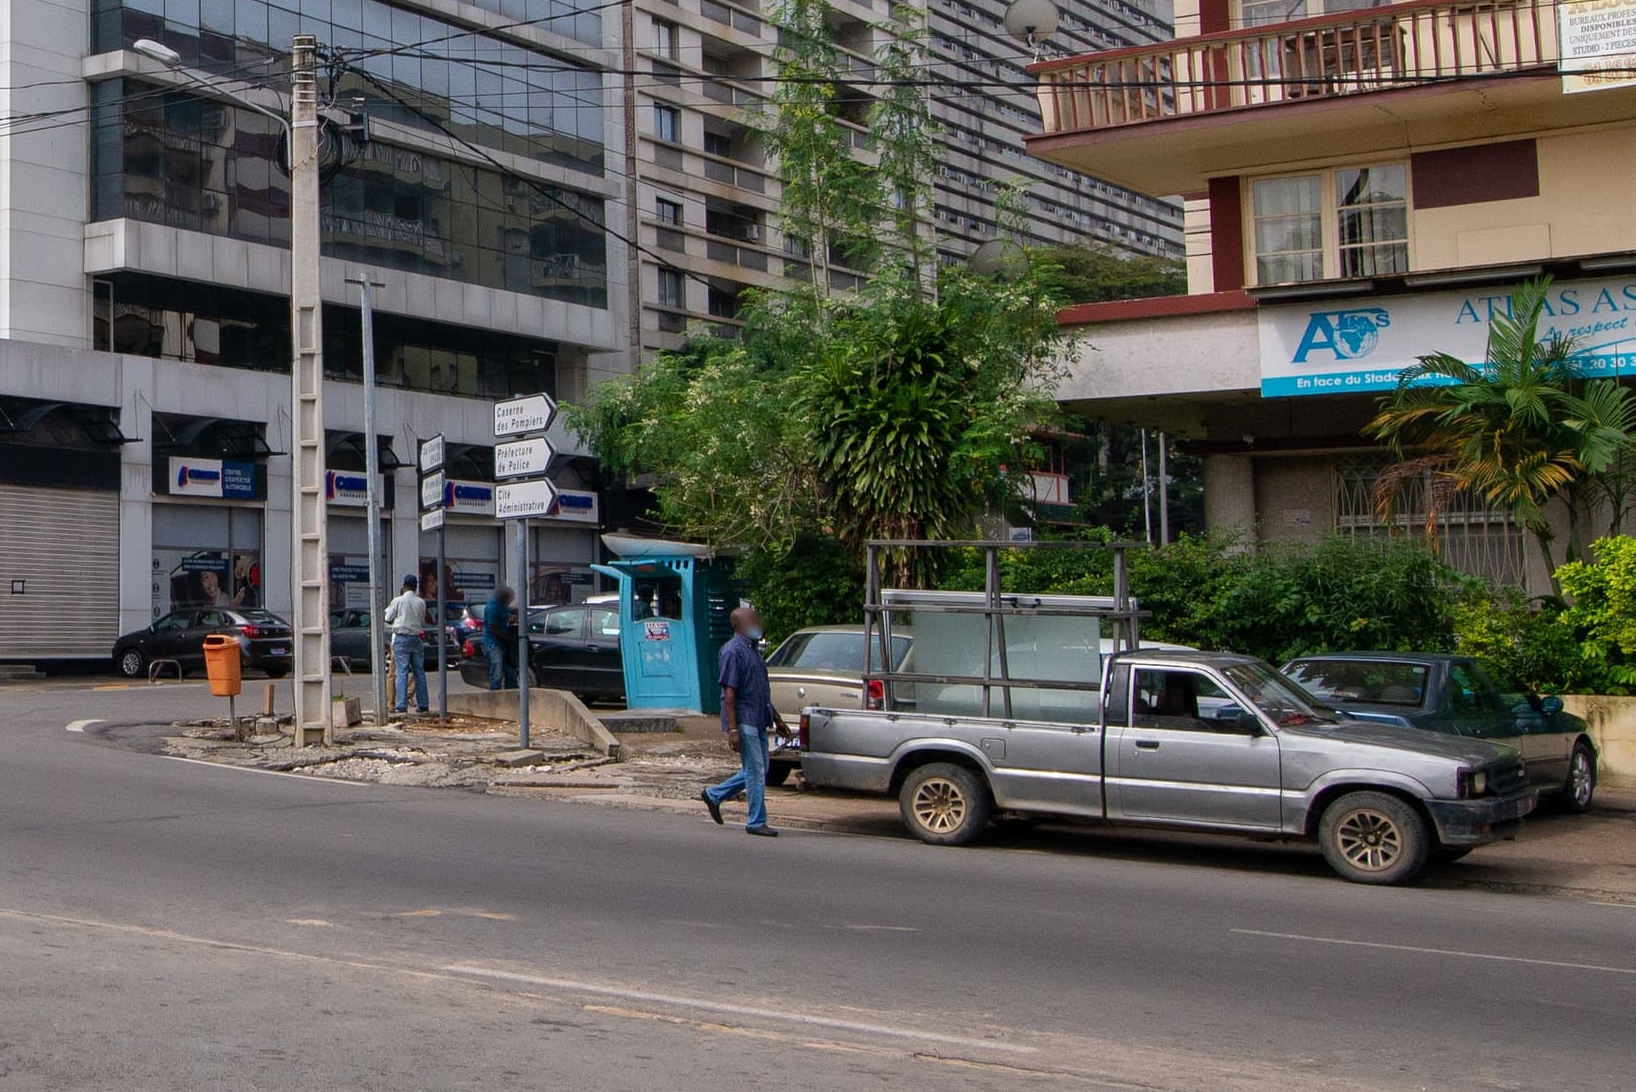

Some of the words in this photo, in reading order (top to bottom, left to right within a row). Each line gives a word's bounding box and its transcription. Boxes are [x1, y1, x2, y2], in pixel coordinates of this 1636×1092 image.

[1569, 13, 1606, 26] BUREAUX
[1569, 30, 1621, 45] UNIQUEMENT
[1572, 44, 1600, 56] STUDIO
[1569, 317, 1628, 337] respect
[1610, 356, 1626, 368] 30
[1297, 378, 1311, 389] En
[1314, 376, 1341, 387] face
[1345, 375, 1361, 385] du
[497, 405, 524, 418] Caserne
[497, 421, 508, 432] des
[511, 416, 543, 429] Pompiers
[498, 445, 533, 459] Préfecture
[498, 462, 506, 472] de
[509, 460, 530, 471] Police
[498, 489, 511, 500] Cité
[499, 499, 545, 514] Administrative
